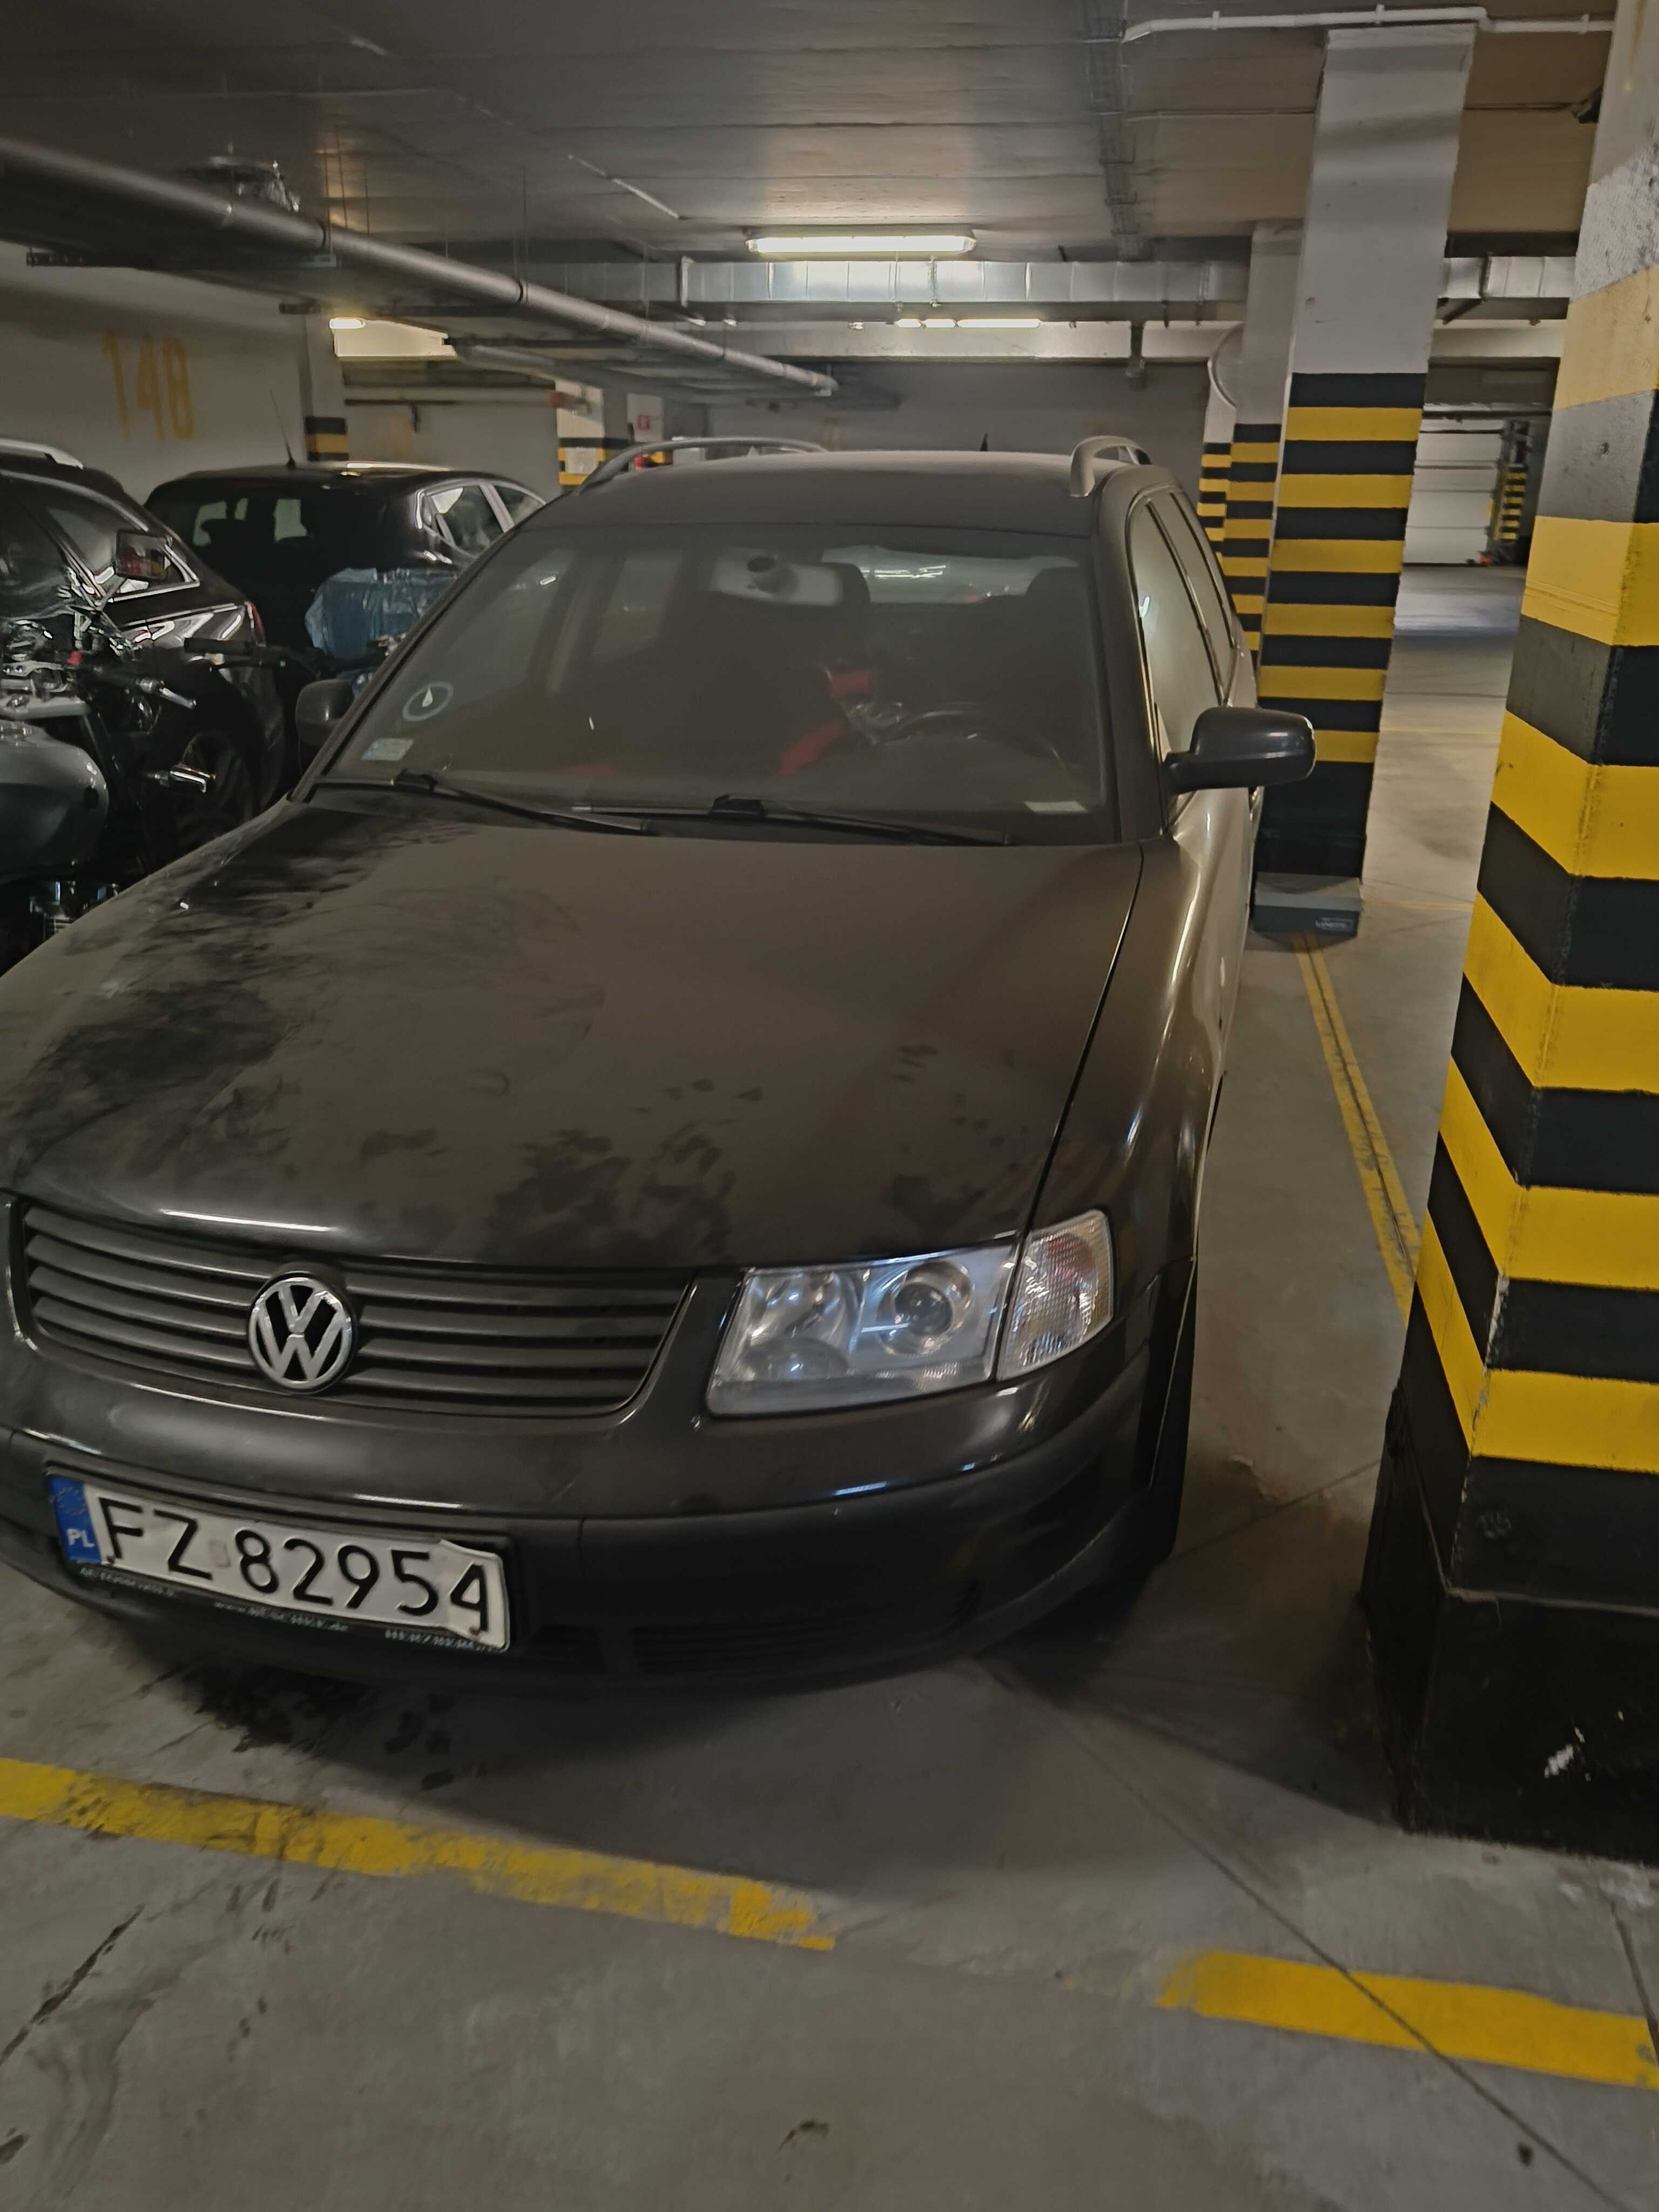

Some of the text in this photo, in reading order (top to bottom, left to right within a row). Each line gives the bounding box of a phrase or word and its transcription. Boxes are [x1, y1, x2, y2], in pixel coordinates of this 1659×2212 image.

[249, 1277, 352, 1389] VW
[67, 1528, 95, 1548] PL
[98, 1496, 489, 1632] FZ 82954
